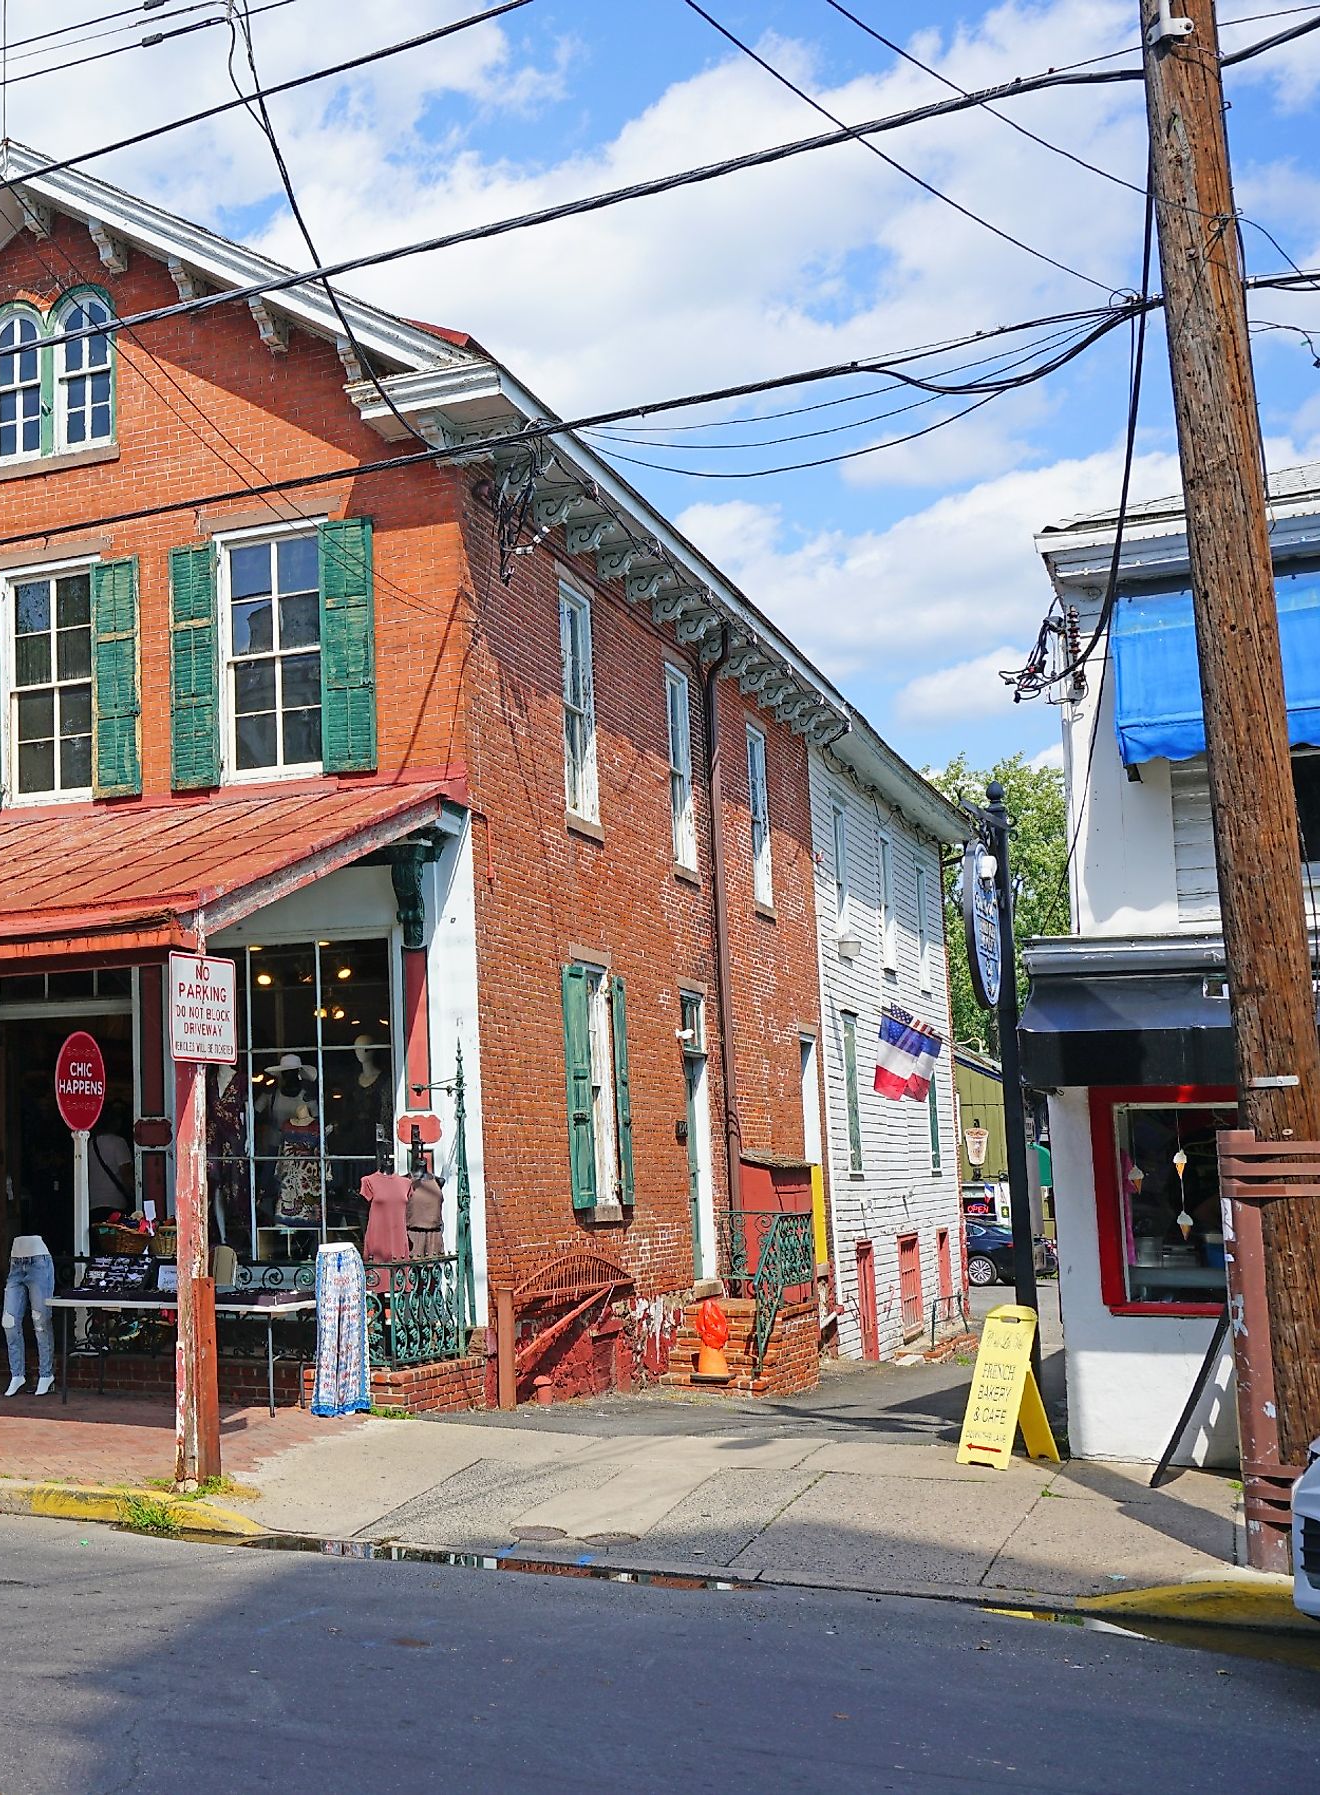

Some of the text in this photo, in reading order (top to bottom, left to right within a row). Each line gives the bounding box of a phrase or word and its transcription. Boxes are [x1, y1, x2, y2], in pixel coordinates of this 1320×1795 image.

[195, 965, 210, 981] NO
[178, 982, 227, 1003] PARKING
[176, 1005, 231, 1022] DO NOT BLOCK
[183, 1022, 222, 1037] DRIVEWAY
[69, 1061, 93, 1077] CHIC
[59, 1079, 103, 1096] HAPPENS
[967, 1204, 989, 1214] OPEN
[981, 1362, 1016, 1381] FRENCH
[977, 1384, 1012, 1402] BAKERY
[973, 1406, 1008, 1424] & CAFE
